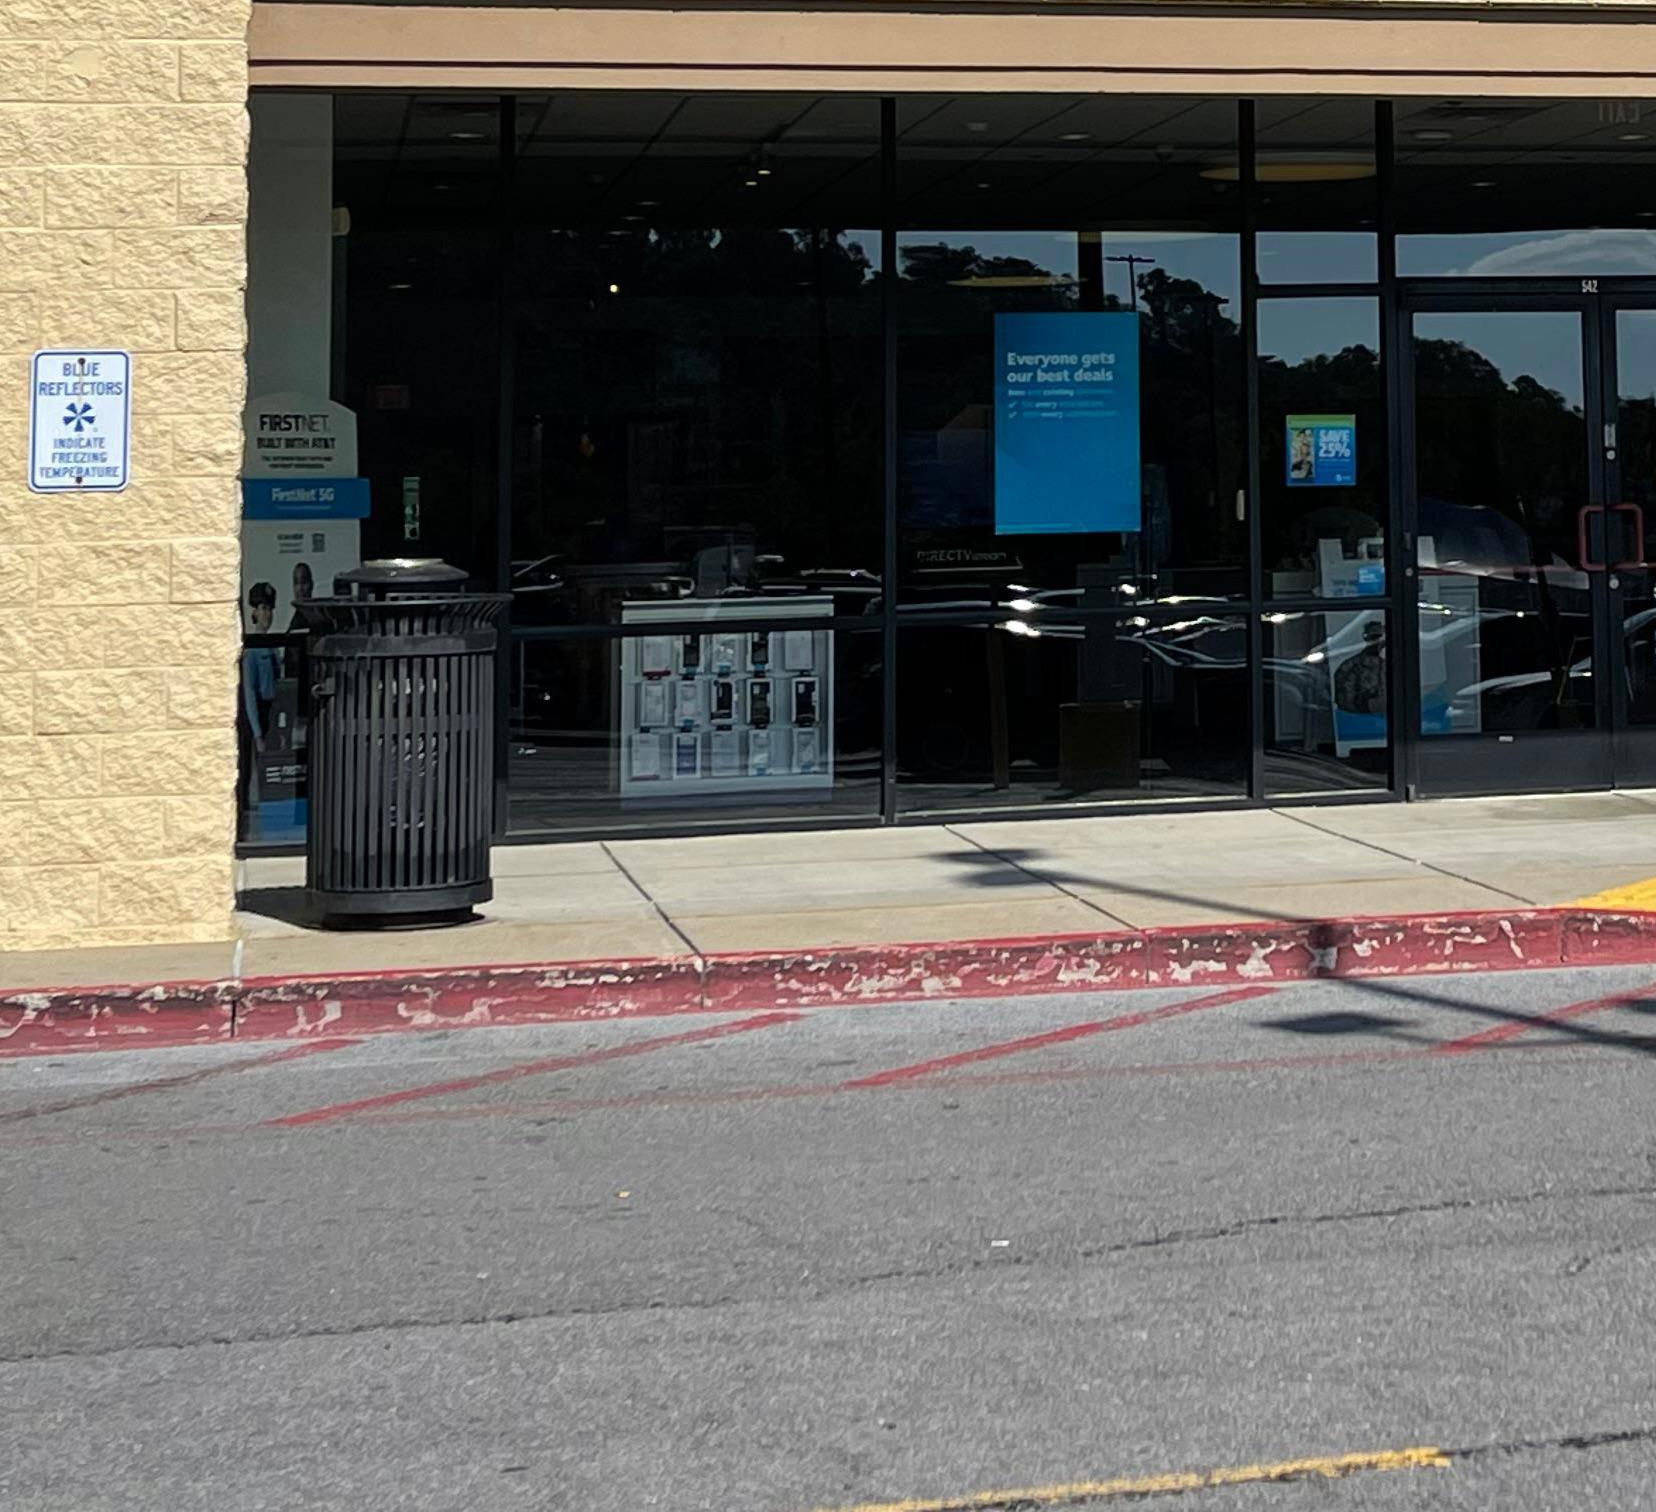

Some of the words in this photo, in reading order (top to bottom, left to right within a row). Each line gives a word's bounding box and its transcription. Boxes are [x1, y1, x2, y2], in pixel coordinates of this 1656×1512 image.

[1582, 279, 1599, 293] 542
[1007, 352, 1078, 368] Everyone
[1081, 352, 1116, 368] gets
[63, 362, 100, 377] BLUE
[1007, 372, 1033, 383] our
[1036, 369, 1071, 383] best
[1074, 368, 1114, 382] deals
[38, 381, 123, 396] REFLECTORS
[1319, 429, 1350, 442] SAVE
[53, 437, 105, 449] INDICATE
[257, 437, 282, 449] BUILT
[312, 437, 336, 449] AT&T
[1319, 440, 1351, 457] 25%
[51, 452, 107, 464] FREEZING
[40, 466, 120, 479] TEMPERATURE
[319, 487, 335, 501] 5G
